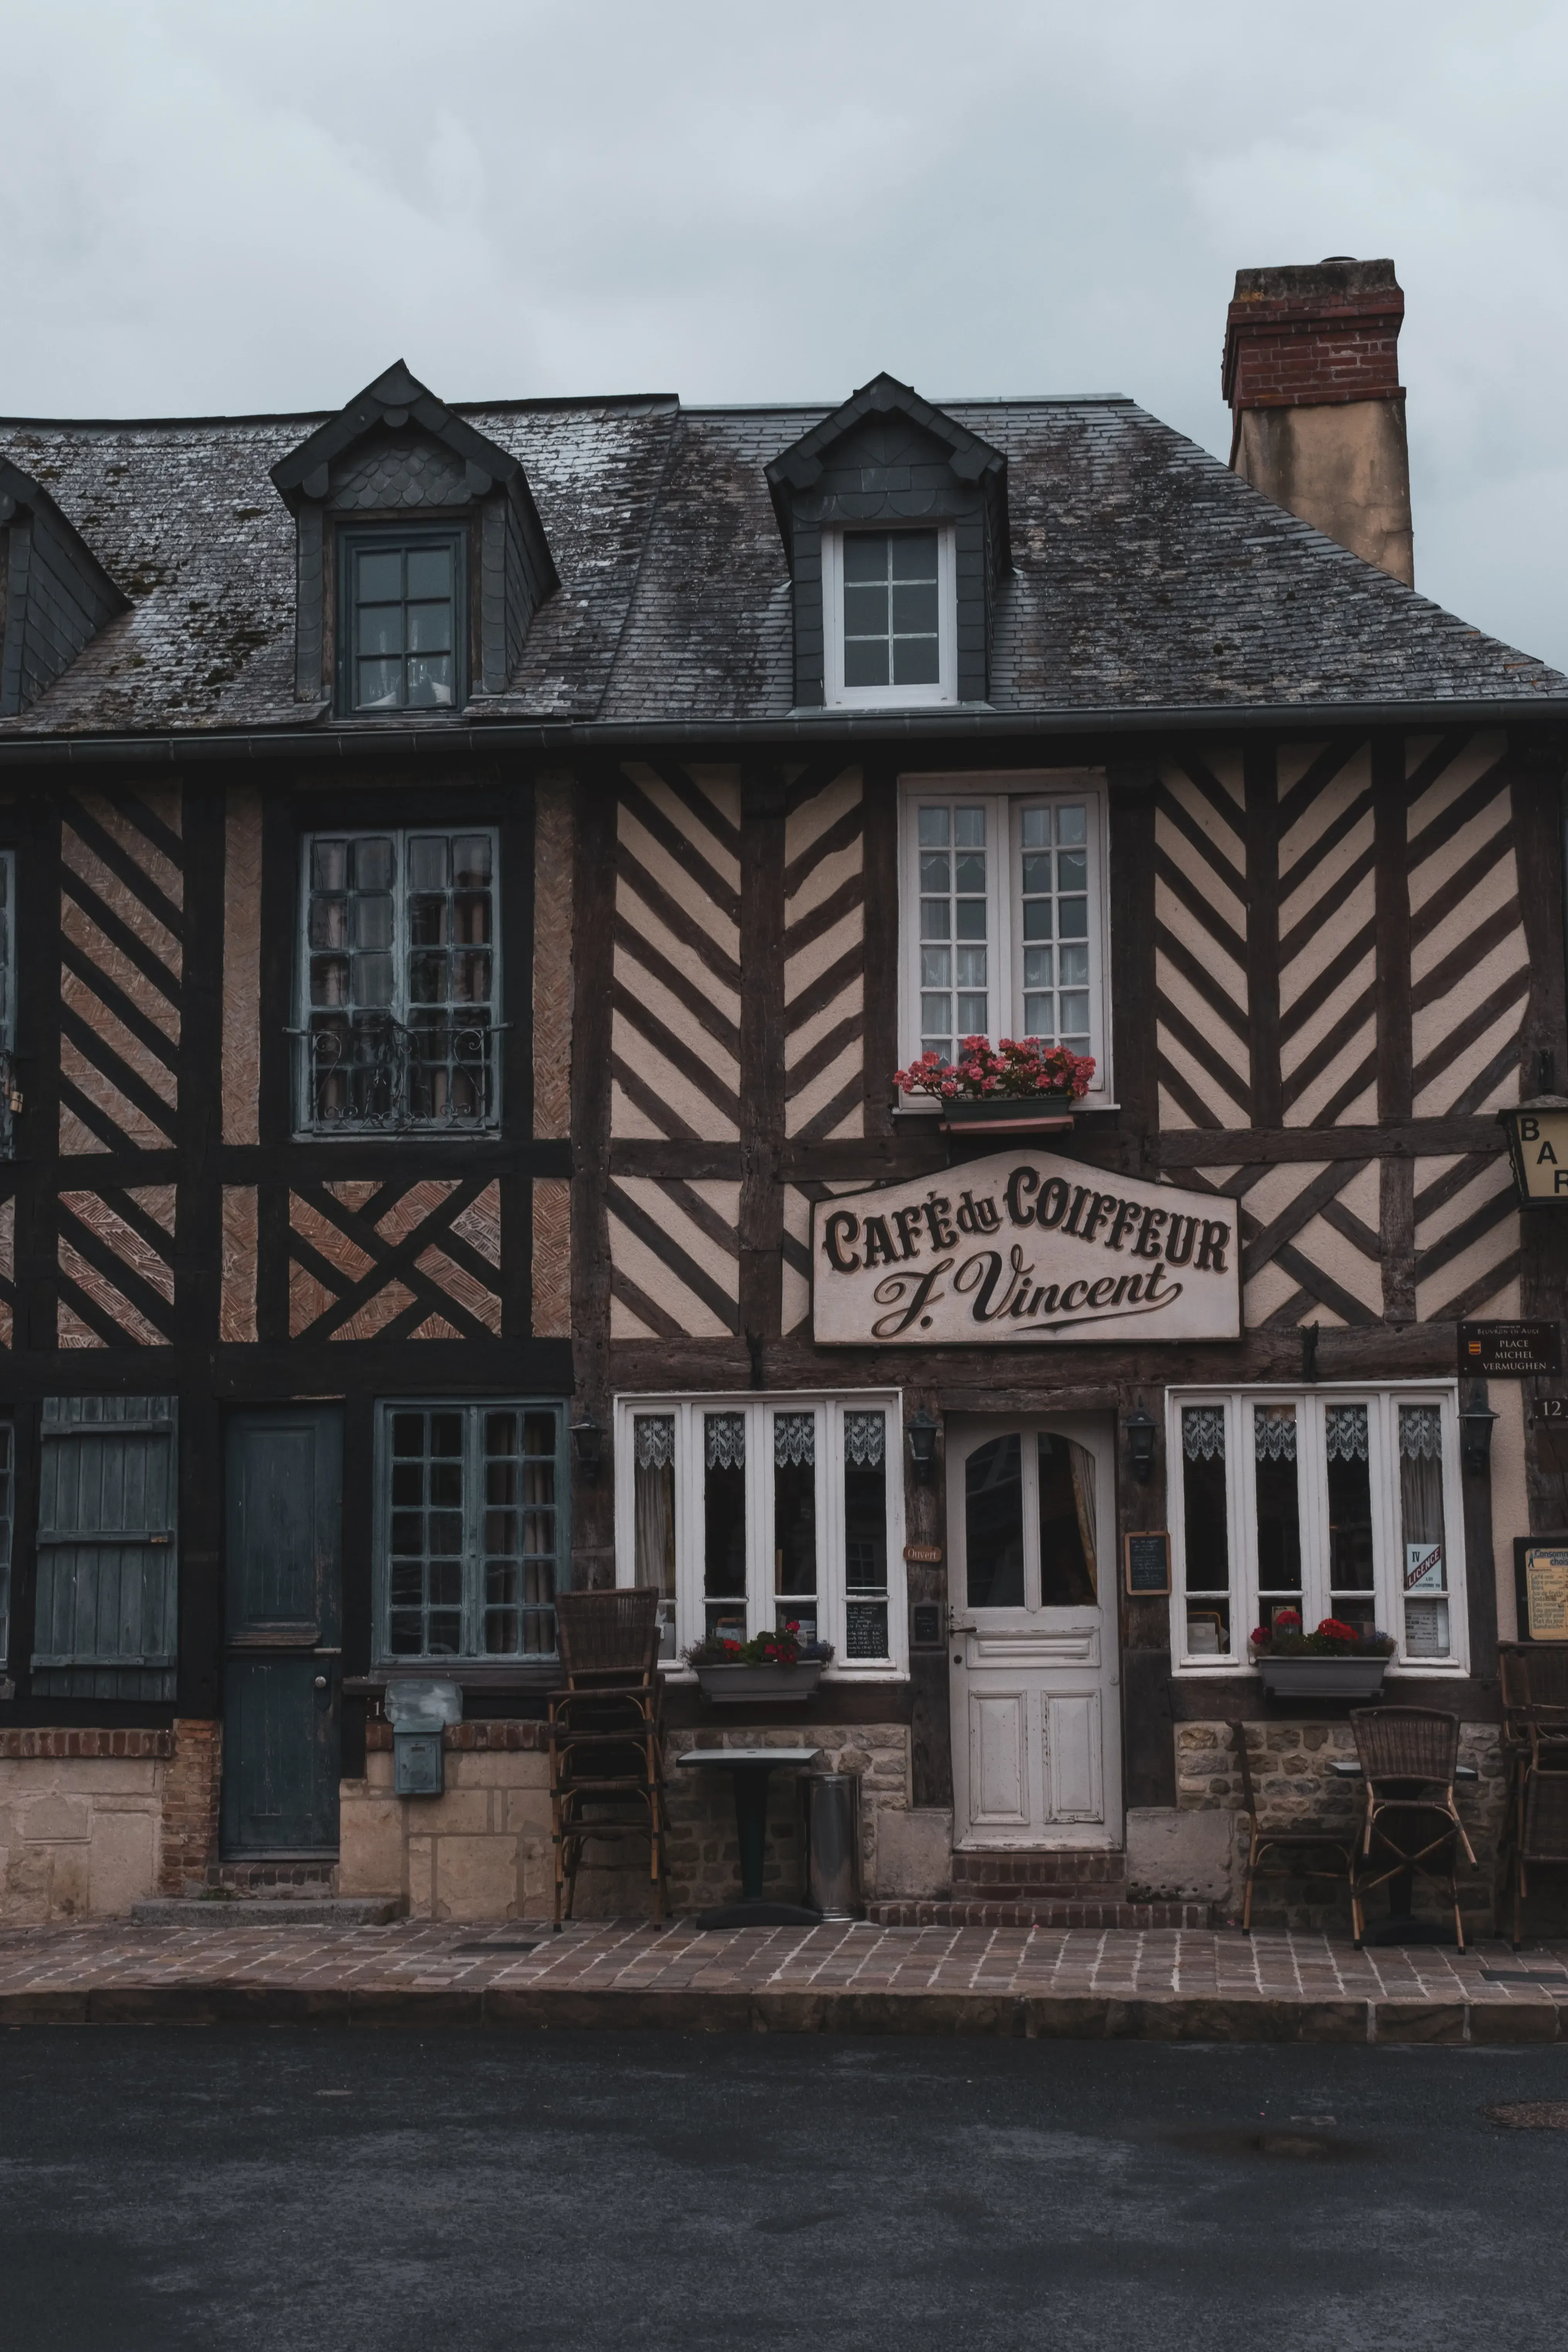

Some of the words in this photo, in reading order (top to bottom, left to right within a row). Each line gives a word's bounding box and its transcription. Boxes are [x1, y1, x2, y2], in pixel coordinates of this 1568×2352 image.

[1521, 1117, 1568, 1194] BAR
[822, 1190, 960, 1274] CAFÉ
[956, 1190, 1004, 1235] du
[1003, 1165, 1232, 1274] COIFFEUR
[953, 1243, 1183, 1331] Vincent
[1542, 1401, 1561, 1416] 12
[908, 1548, 937, 1560] Ouvert
[1409, 1549, 1439, 1587] LICENCE
[1412, 1551, 1421, 1562] IV
